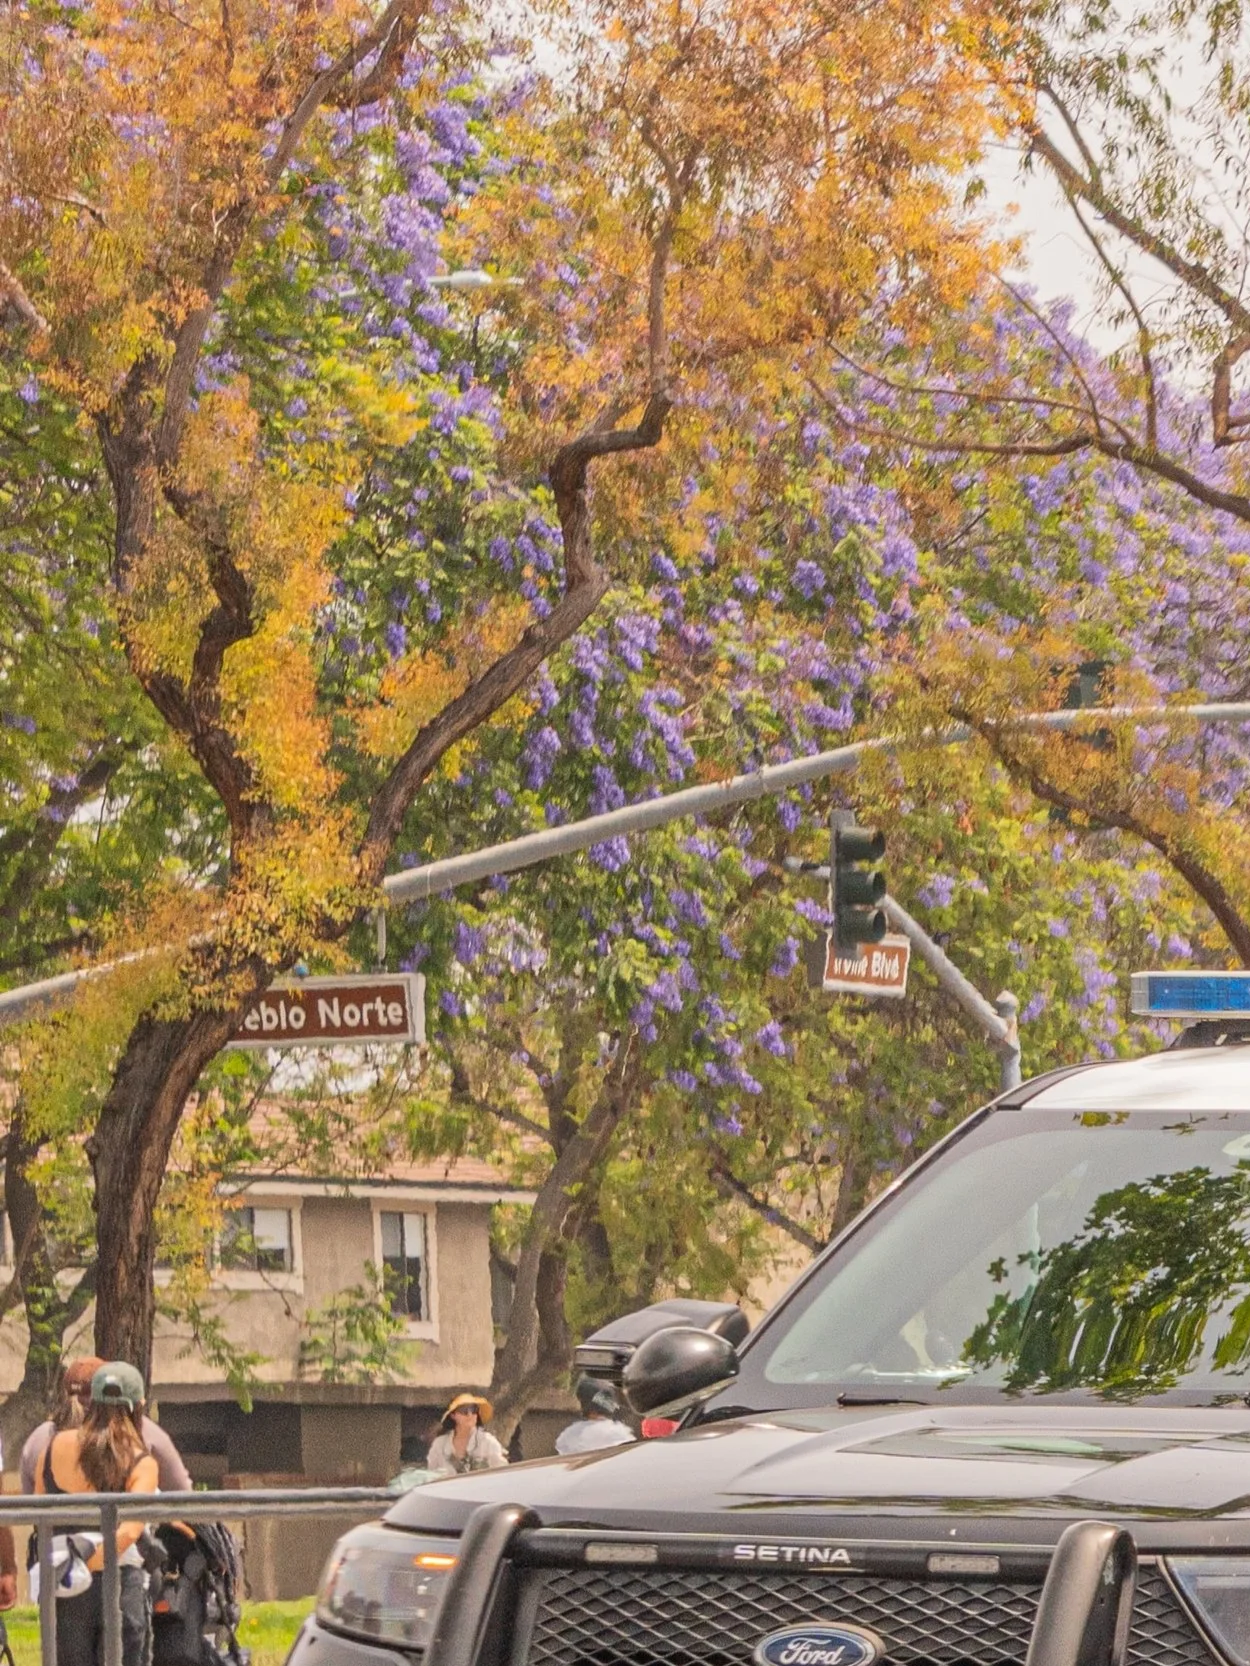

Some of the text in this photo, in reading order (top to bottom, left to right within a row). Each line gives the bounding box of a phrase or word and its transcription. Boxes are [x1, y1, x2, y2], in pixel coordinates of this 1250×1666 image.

[871, 951, 899, 980] Blvd
[240, 996, 403, 1031] eblo Norte
[734, 1545, 851, 1563] SETINA
[779, 1637, 845, 1665] Ford
